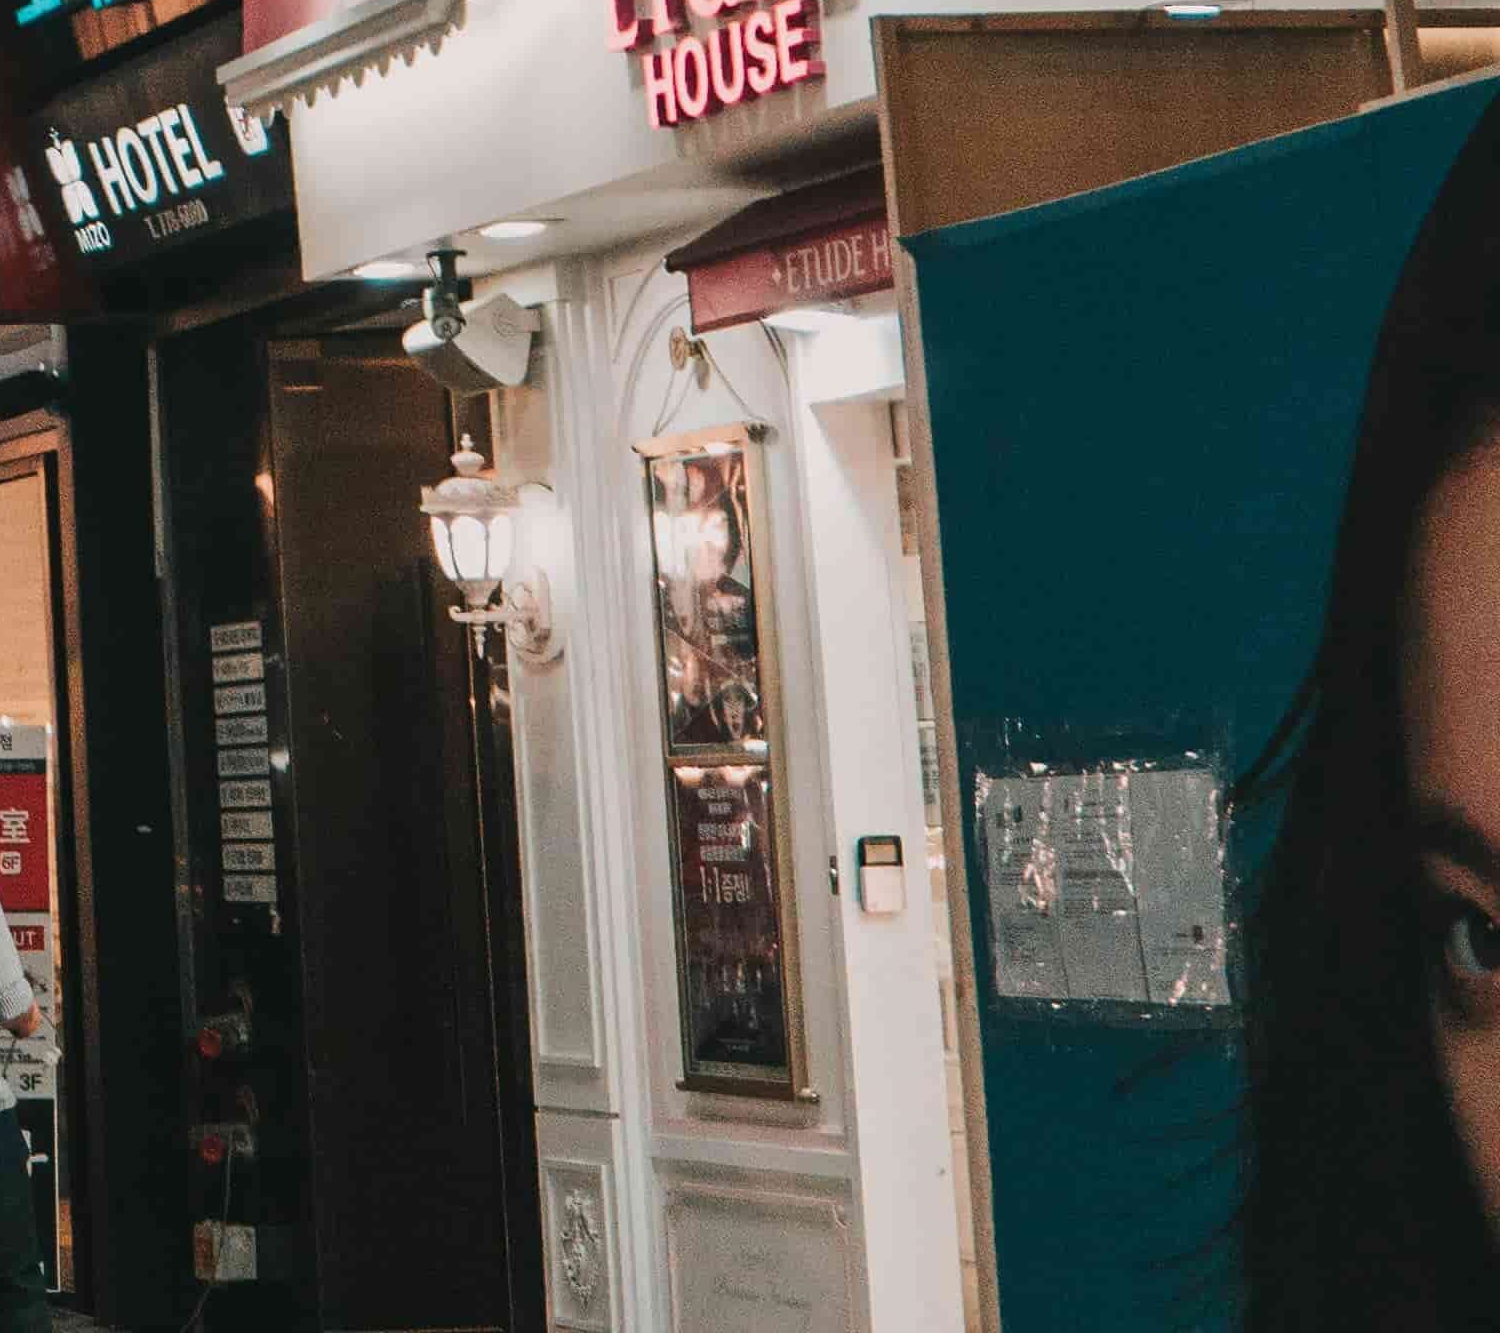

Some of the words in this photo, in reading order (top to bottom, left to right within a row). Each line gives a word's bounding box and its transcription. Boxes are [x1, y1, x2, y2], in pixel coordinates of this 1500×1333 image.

[88, 104, 224, 216] HOTEL
[74, 221, 111, 253] MIZO
[2, 854, 20, 870] 6F
[18, 1072, 43, 1091] 3F
